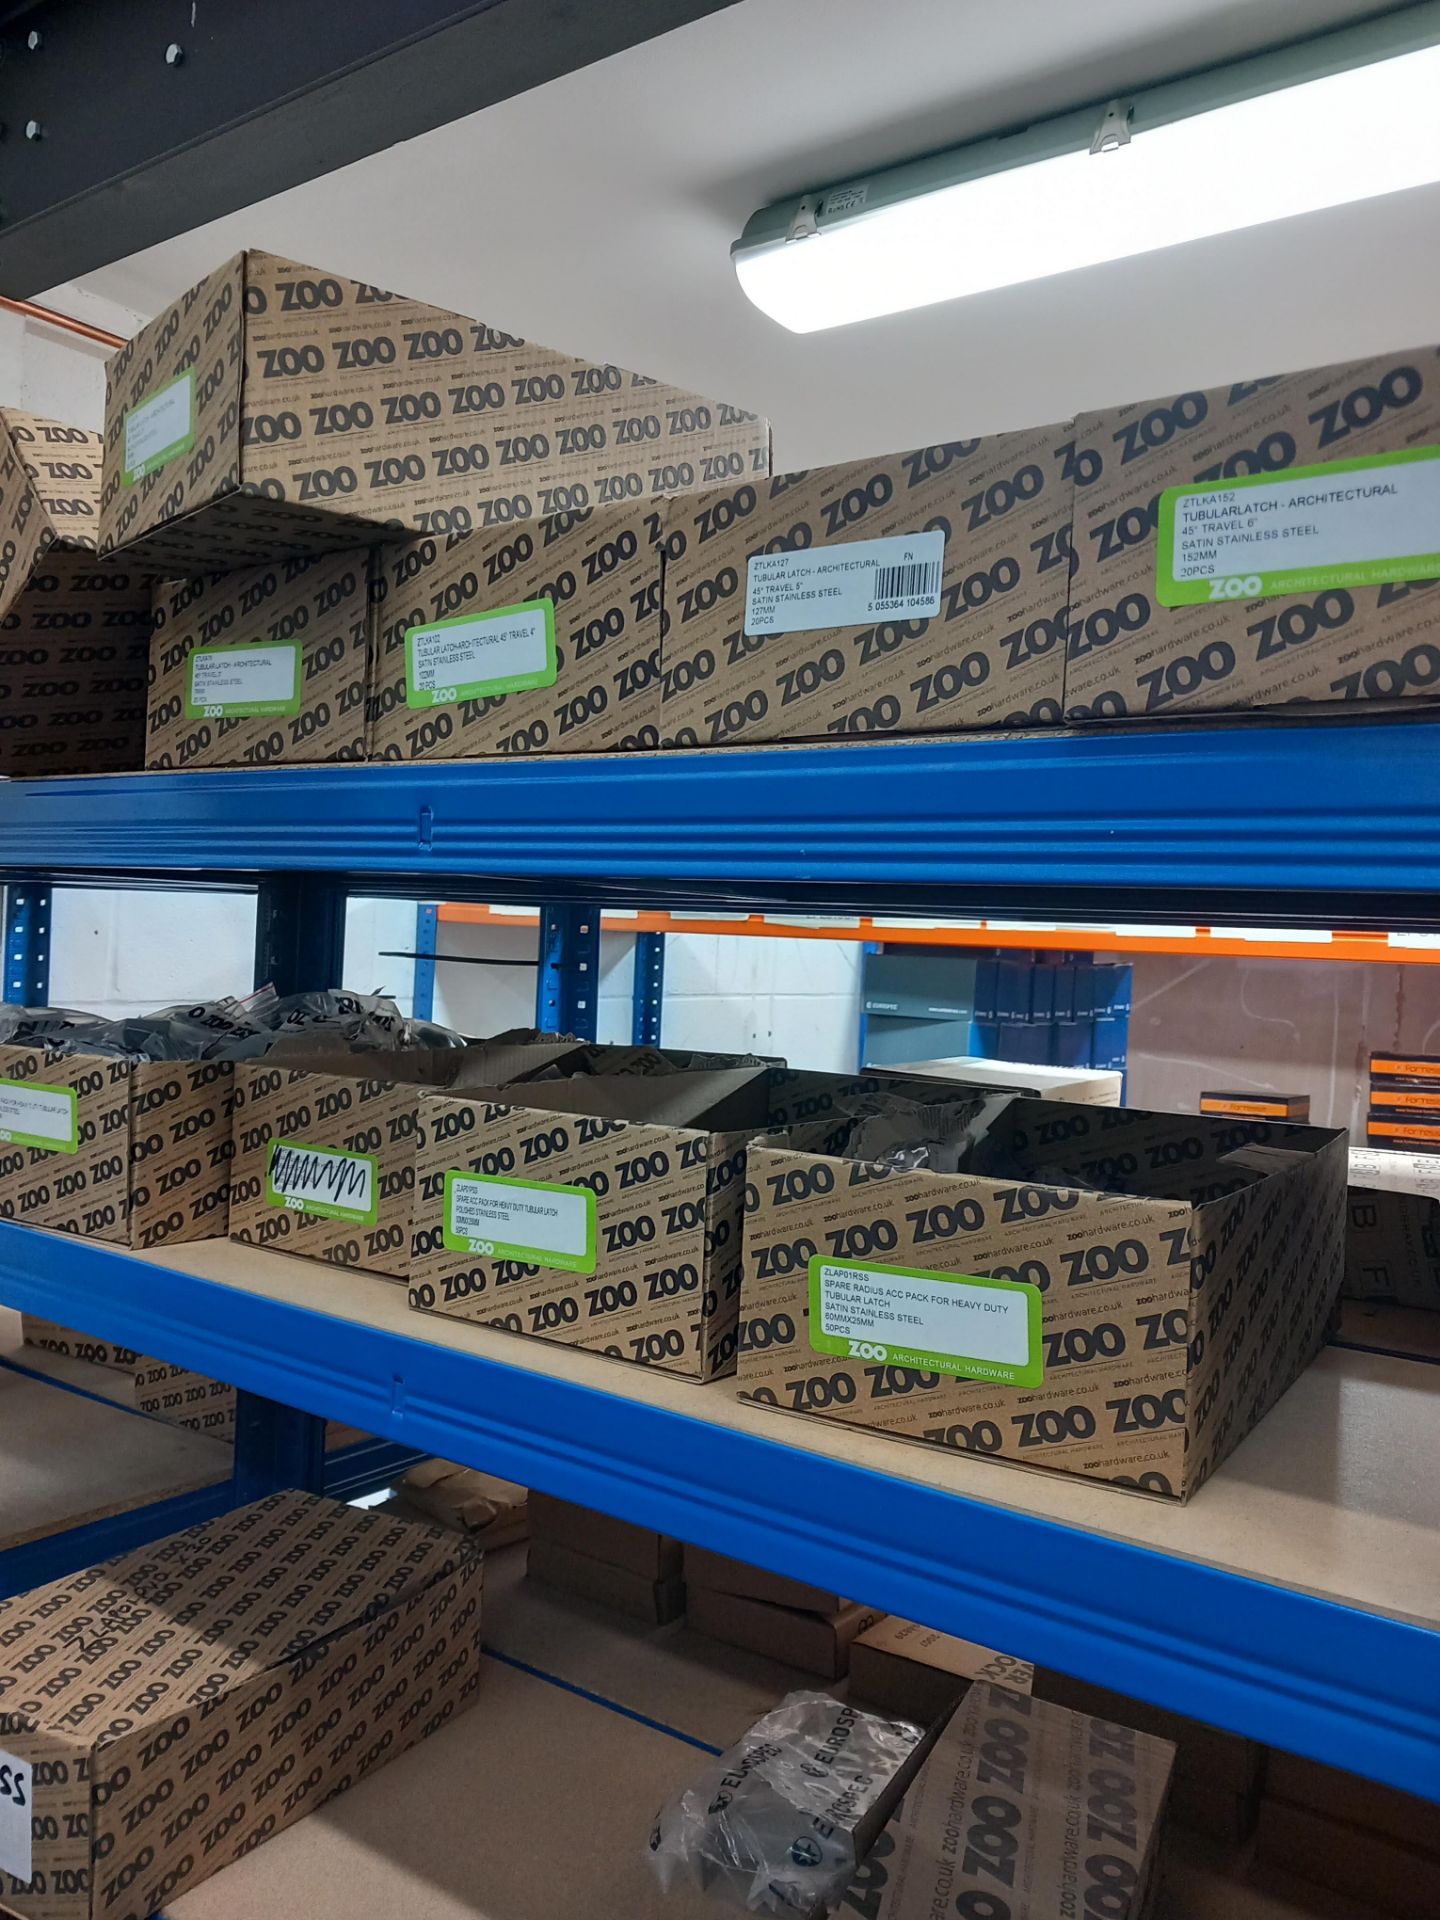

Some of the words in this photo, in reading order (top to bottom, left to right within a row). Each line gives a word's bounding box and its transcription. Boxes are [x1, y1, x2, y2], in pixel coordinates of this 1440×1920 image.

[204, 283, 231, 341] ZOO
[276, 279, 343, 310] ZOO
[257, 345, 324, 378] ZOO
[404, 329, 462, 360] ZOO
[449, 383, 504, 414] ZOO
[572, 366, 621, 395] ZOO
[310, 402, 373, 435] ZOO
[1309, 365, 1422, 448] ZOO
[1113, 392, 1208, 464] ZOO
[432, 444, 489, 476] ZOO
[821, 474, 892, 538] ZOO
[962, 465, 1043, 531] ZOO
[1182, 491, 1236, 509] ZTLKA152
[1288, 483, 1398, 509] ARCHITECTURAL
[694, 485, 756, 544] ZOO
[1201, 519, 1245, 533] TRAVEL
[1181, 538, 1214, 551] SATIN
[1216, 529, 1279, 547] STAINLESS
[1282, 524, 1320, 539] STEEL
[1182, 549, 1218, 562] 152MM
[582, 530, 637, 585] ZOO
[753, 570, 786, 583] TUBULAR
[787, 567, 811, 579] LATCH
[816, 559, 881, 576] ARCHITECTURAL
[677, 567, 739, 623] ZOO
[751, 595, 774, 607] SATIN
[774, 590, 817, 604] STAINLESS
[817, 587, 843, 599] STEEL
[765, 583, 795, 595] TRAVEL
[1209, 575, 1264, 600] ZOO
[867, 601, 873, 611] 5
[1247, 588, 1354, 661] ZOO
[431, 687, 457, 704] ZOO
[776, 649, 845, 706] ZOO
[910, 652, 989, 713] ZOO
[203, 704, 224, 718] ZOO
[554, 685, 607, 735] ZOO
[248, 1070, 282, 1101] ZOO
[169, 1108, 216, 1144] ZOO
[431, 1107, 475, 1142] ZOO
[520, 1127, 569, 1164] ZOO
[156, 1159, 201, 1196] ZOO
[615, 1151, 669, 1189] ZOO
[767, 1163, 834, 1206] ZOO
[284, 1195, 304, 1211] ZOO
[906, 1199, 984, 1243] ZOO
[364, 1224, 404, 1256] ZOO
[468, 1239, 495, 1256] ZOO
[602, 1216, 655, 1253] ZOO
[825, 1220, 898, 1261] ZOO
[823, 1267, 870, 1282] ZLAP01RSS
[1060, 1239, 1149, 1286] ZOO
[584, 1281, 637, 1317] ZOO
[643, 1264, 698, 1301] ZOO
[824, 1279, 852, 1292] SPARE
[853, 1283, 884, 1297] RADIUS
[885, 1288, 904, 1300] ACC
[905, 1291, 929, 1303] PACK
[930, 1295, 950, 1306] FOR
[951, 1298, 982, 1311] HEAVY
[984, 1302, 1009, 1315] DUTY
[825, 1290, 861, 1304] TUBULAR
[863, 1296, 891, 1308] LATCH
[824, 1301, 849, 1313] SATIN
[850, 1305, 895, 1321] STAINLESS
[896, 1313, 924, 1326] STEEL
[825, 1322, 851, 1335] 50PCS
[848, 1339, 888, 1361] ZOO
[892, 1352, 962, 1371] ARCHITECTURAL
[964, 1364, 1016, 1381] HARDWARE
[1042, 1323, 1125, 1368] ZOO
[1011, 1406, 1096, 1447] ZOO
[98, 1660, 141, 1689] ZOO
[125, 1683, 169, 1715] ZOO
[420, 1700, 454, 1739] ZOO
[216, 1744, 262, 1795] ZOO
[977, 1718, 1030, 1795] ZOO
[122, 1779, 174, 1835] ZOO
[1087, 1769, 1138, 1851] ZOO
[962, 1796, 1022, 1889] ZOO
[101, 1846, 154, 1908] ZOO
